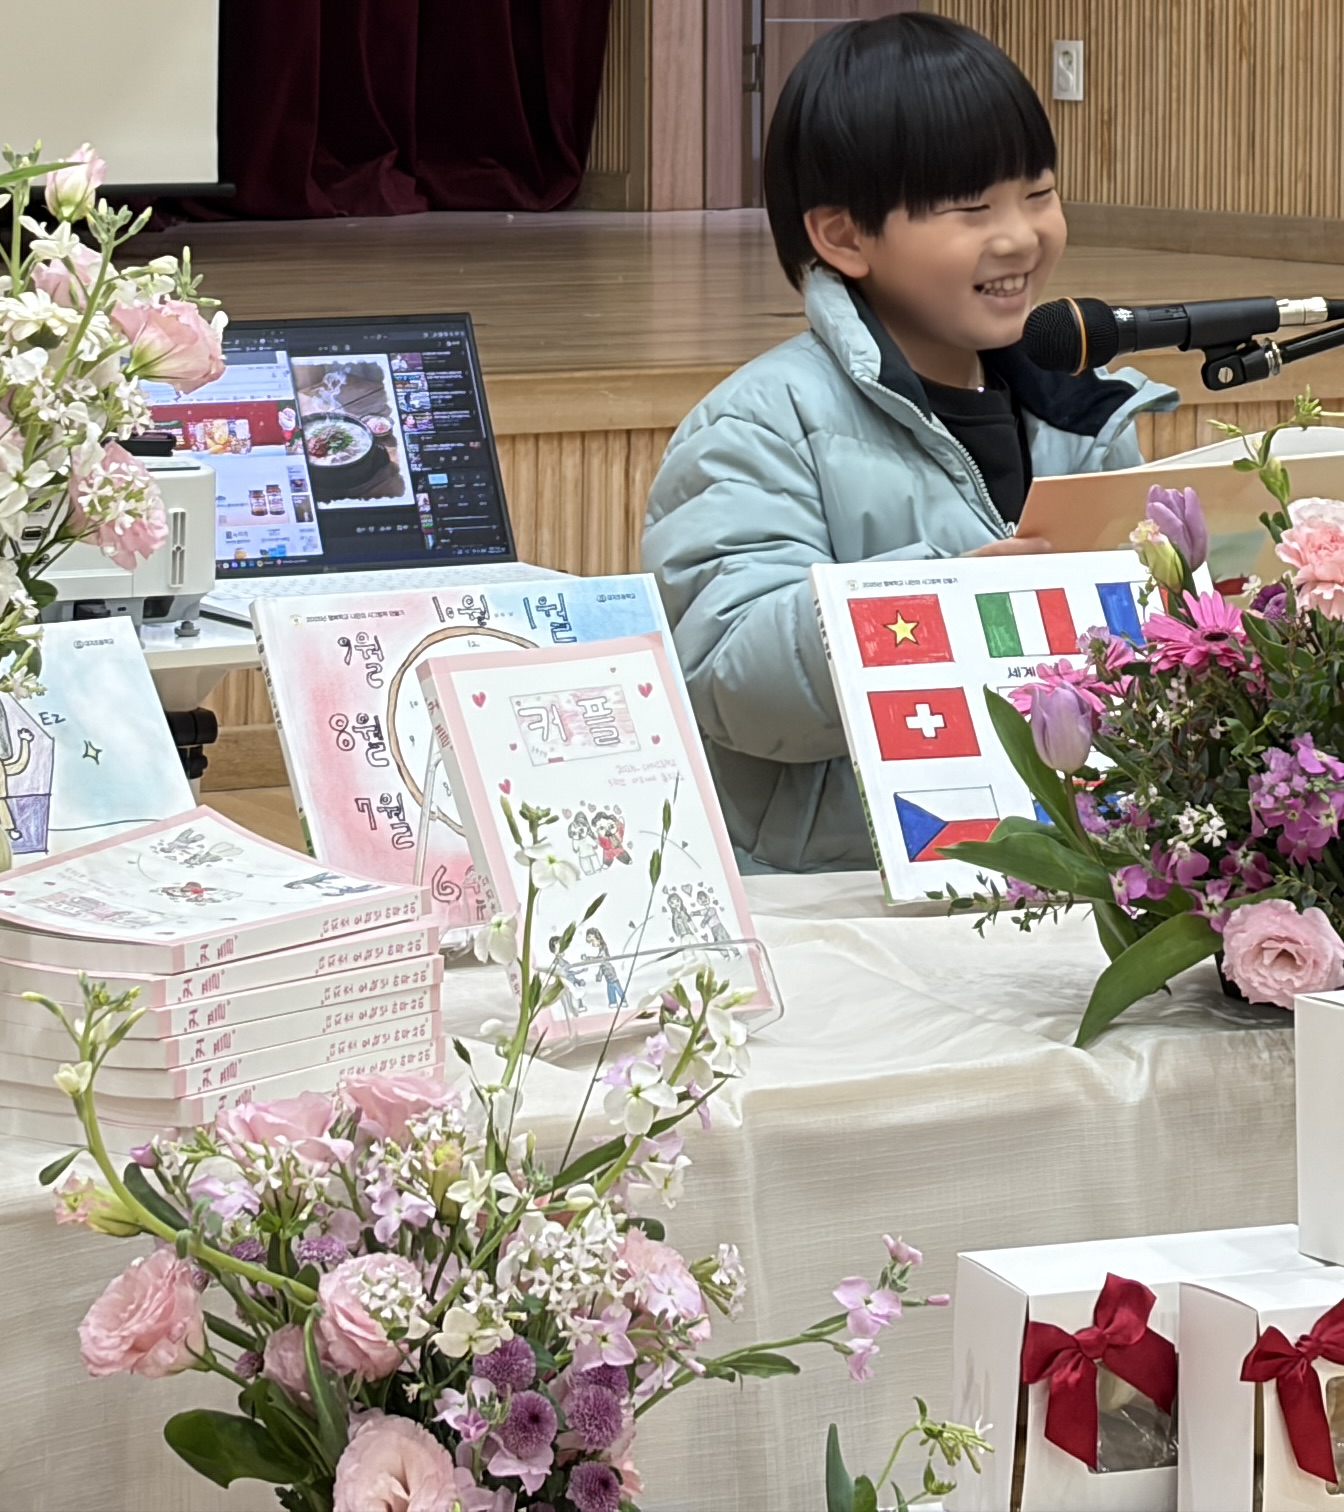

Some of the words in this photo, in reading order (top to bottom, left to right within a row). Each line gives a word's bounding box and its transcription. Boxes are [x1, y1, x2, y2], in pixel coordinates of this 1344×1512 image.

[523, 593, 577, 643] 1월
[338, 632, 385, 689] 9월
[329, 713, 389, 767] 8월
[355, 792, 415, 850] 7월
